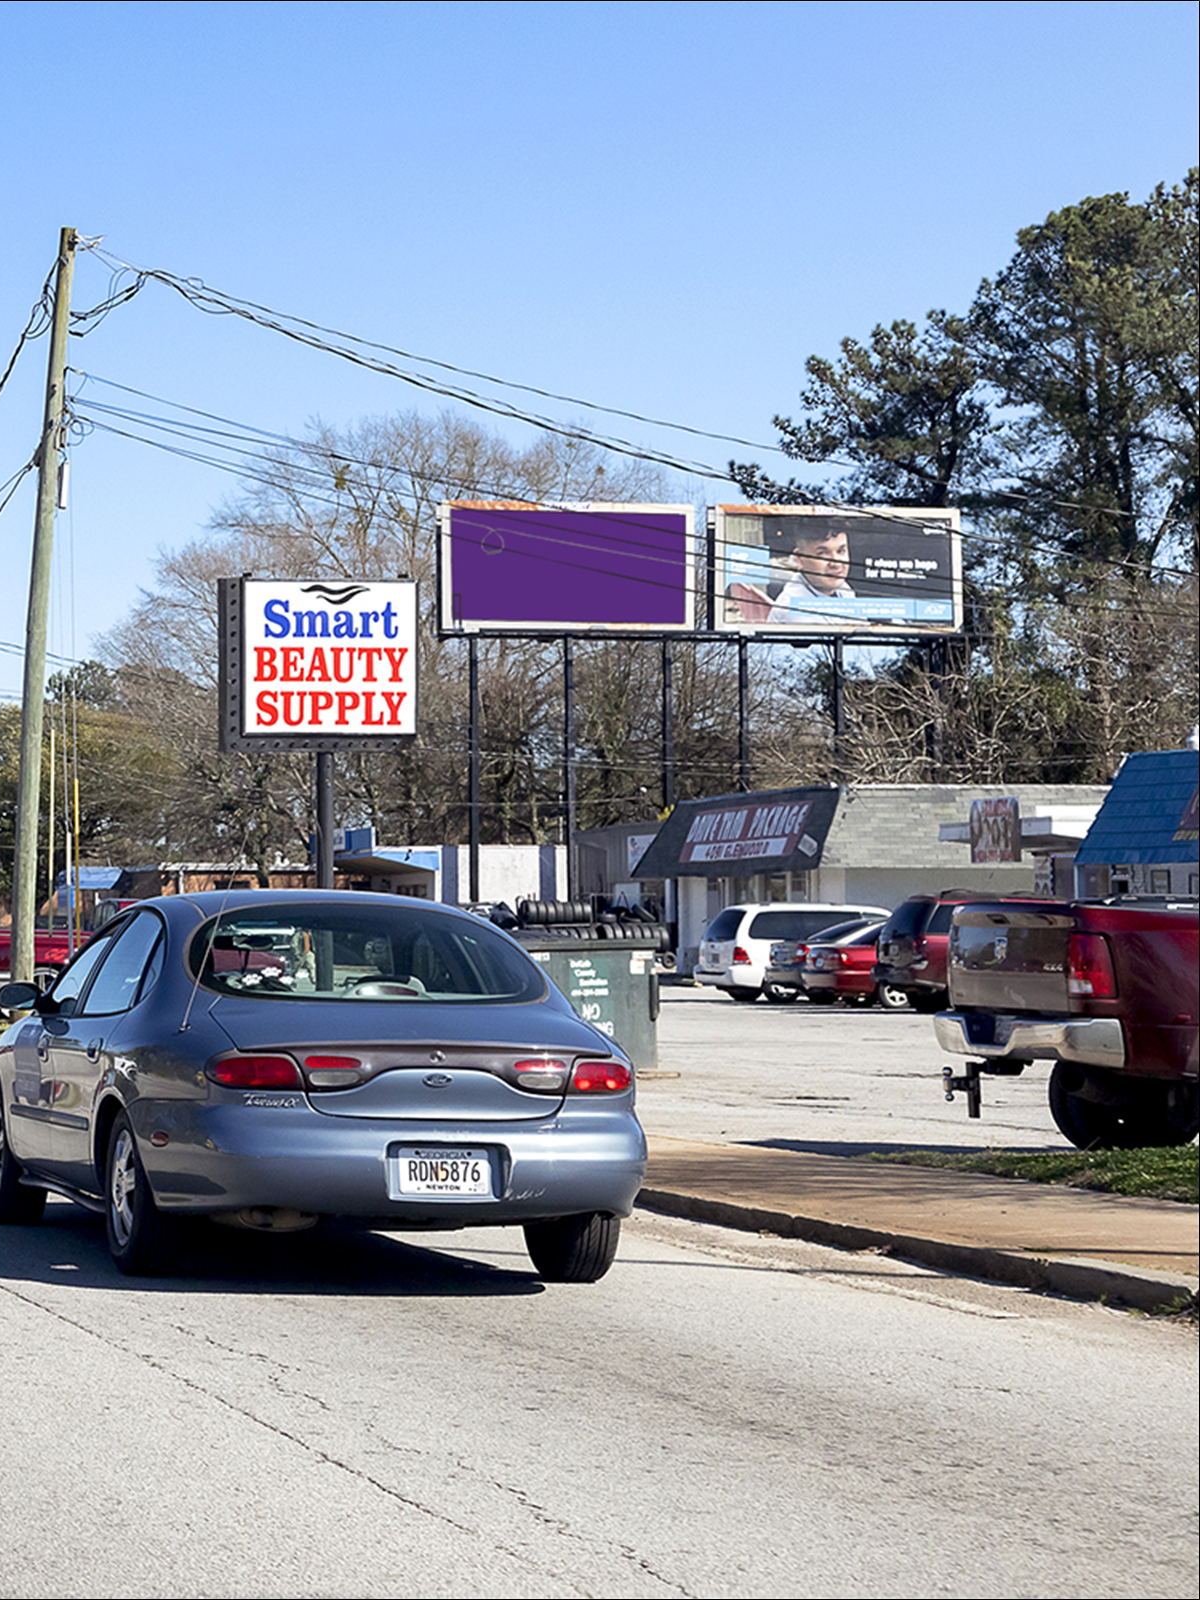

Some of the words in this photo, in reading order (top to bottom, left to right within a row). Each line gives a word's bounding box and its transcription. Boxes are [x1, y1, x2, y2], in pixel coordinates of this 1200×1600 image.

[915, 558, 938, 571] hope
[263, 599, 399, 639] Smart
[253, 646, 409, 683] BEAUTY
[255, 690, 408, 727] SUPPLY
[747, 803, 809, 839] PACKAGE
[582, 1002, 601, 1020] NO
[418, 1150, 467, 1160] GEORGIA
[408, 1160, 481, 1182] RDN5876
